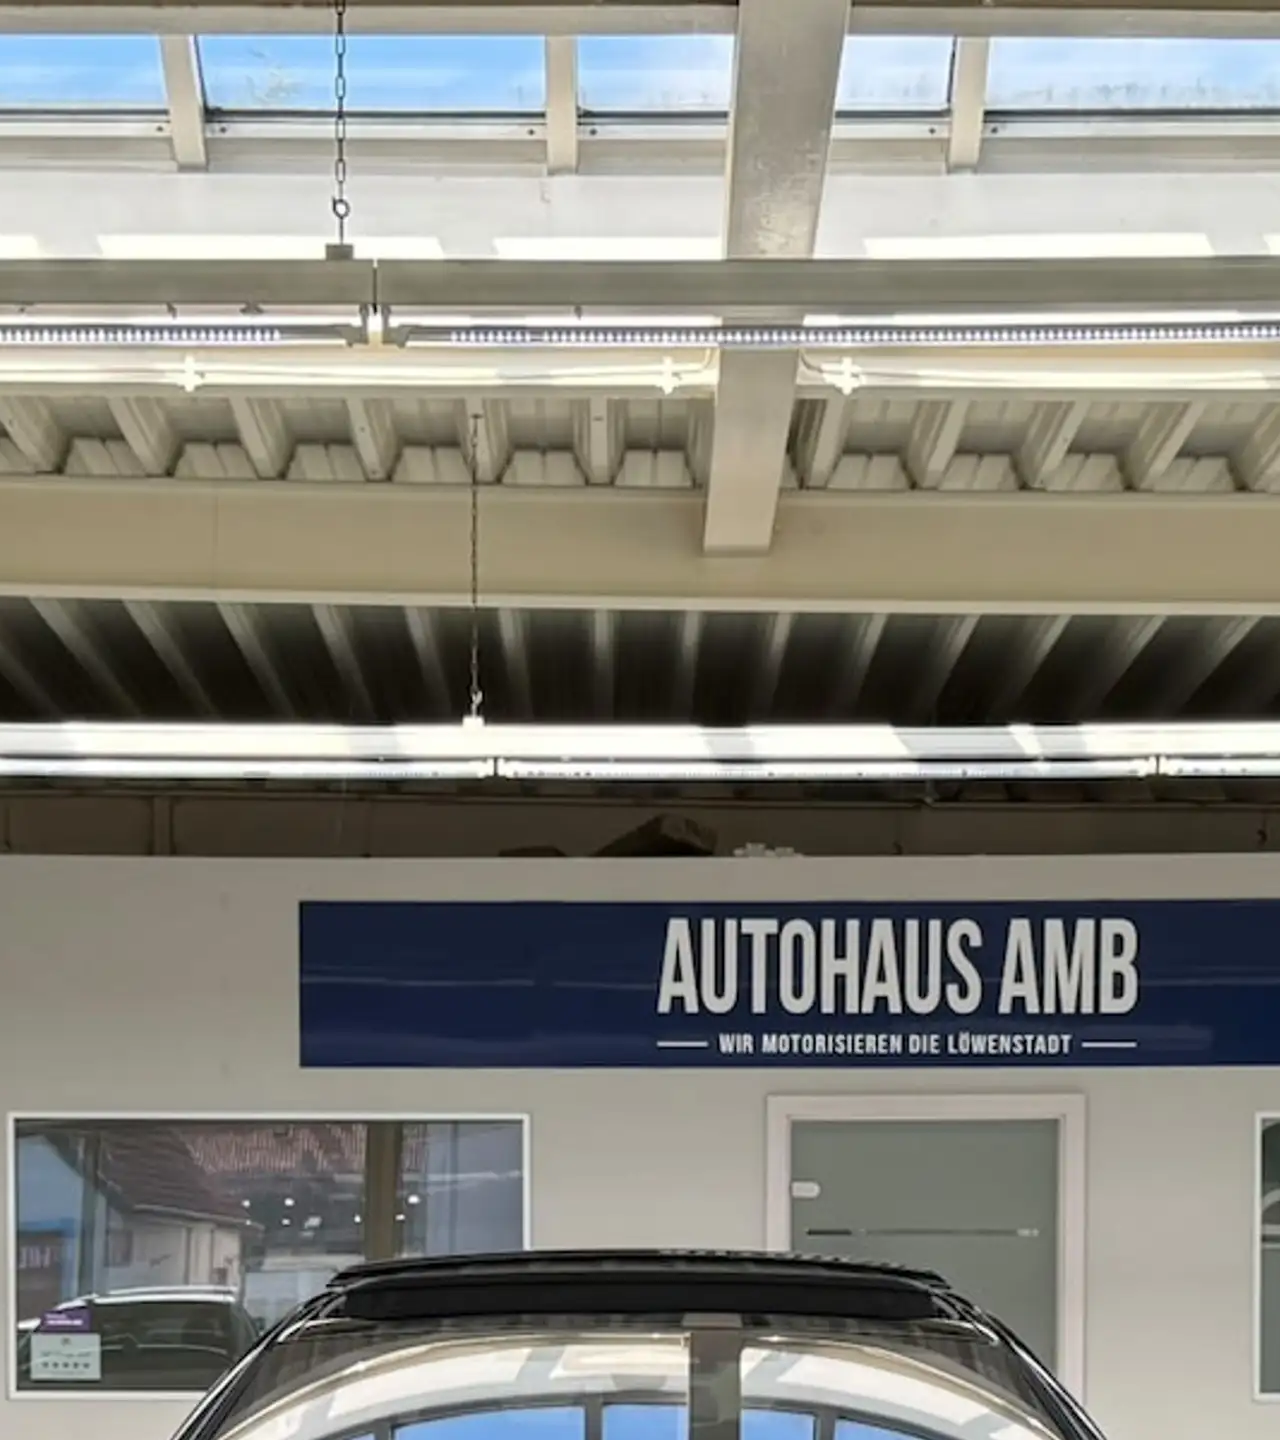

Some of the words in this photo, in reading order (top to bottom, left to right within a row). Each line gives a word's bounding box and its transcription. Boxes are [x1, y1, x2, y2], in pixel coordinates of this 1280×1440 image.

[656, 917, 983, 1016] AUTOHAUS
[998, 917, 1140, 1015] AMB
[718, 1033, 754, 1055] WIR
[761, 1033, 903, 1055] MOTORISIEREN
[908, 1033, 941, 1055] DIE
[946, 1031, 1073, 1055] LÖWENSTADT
